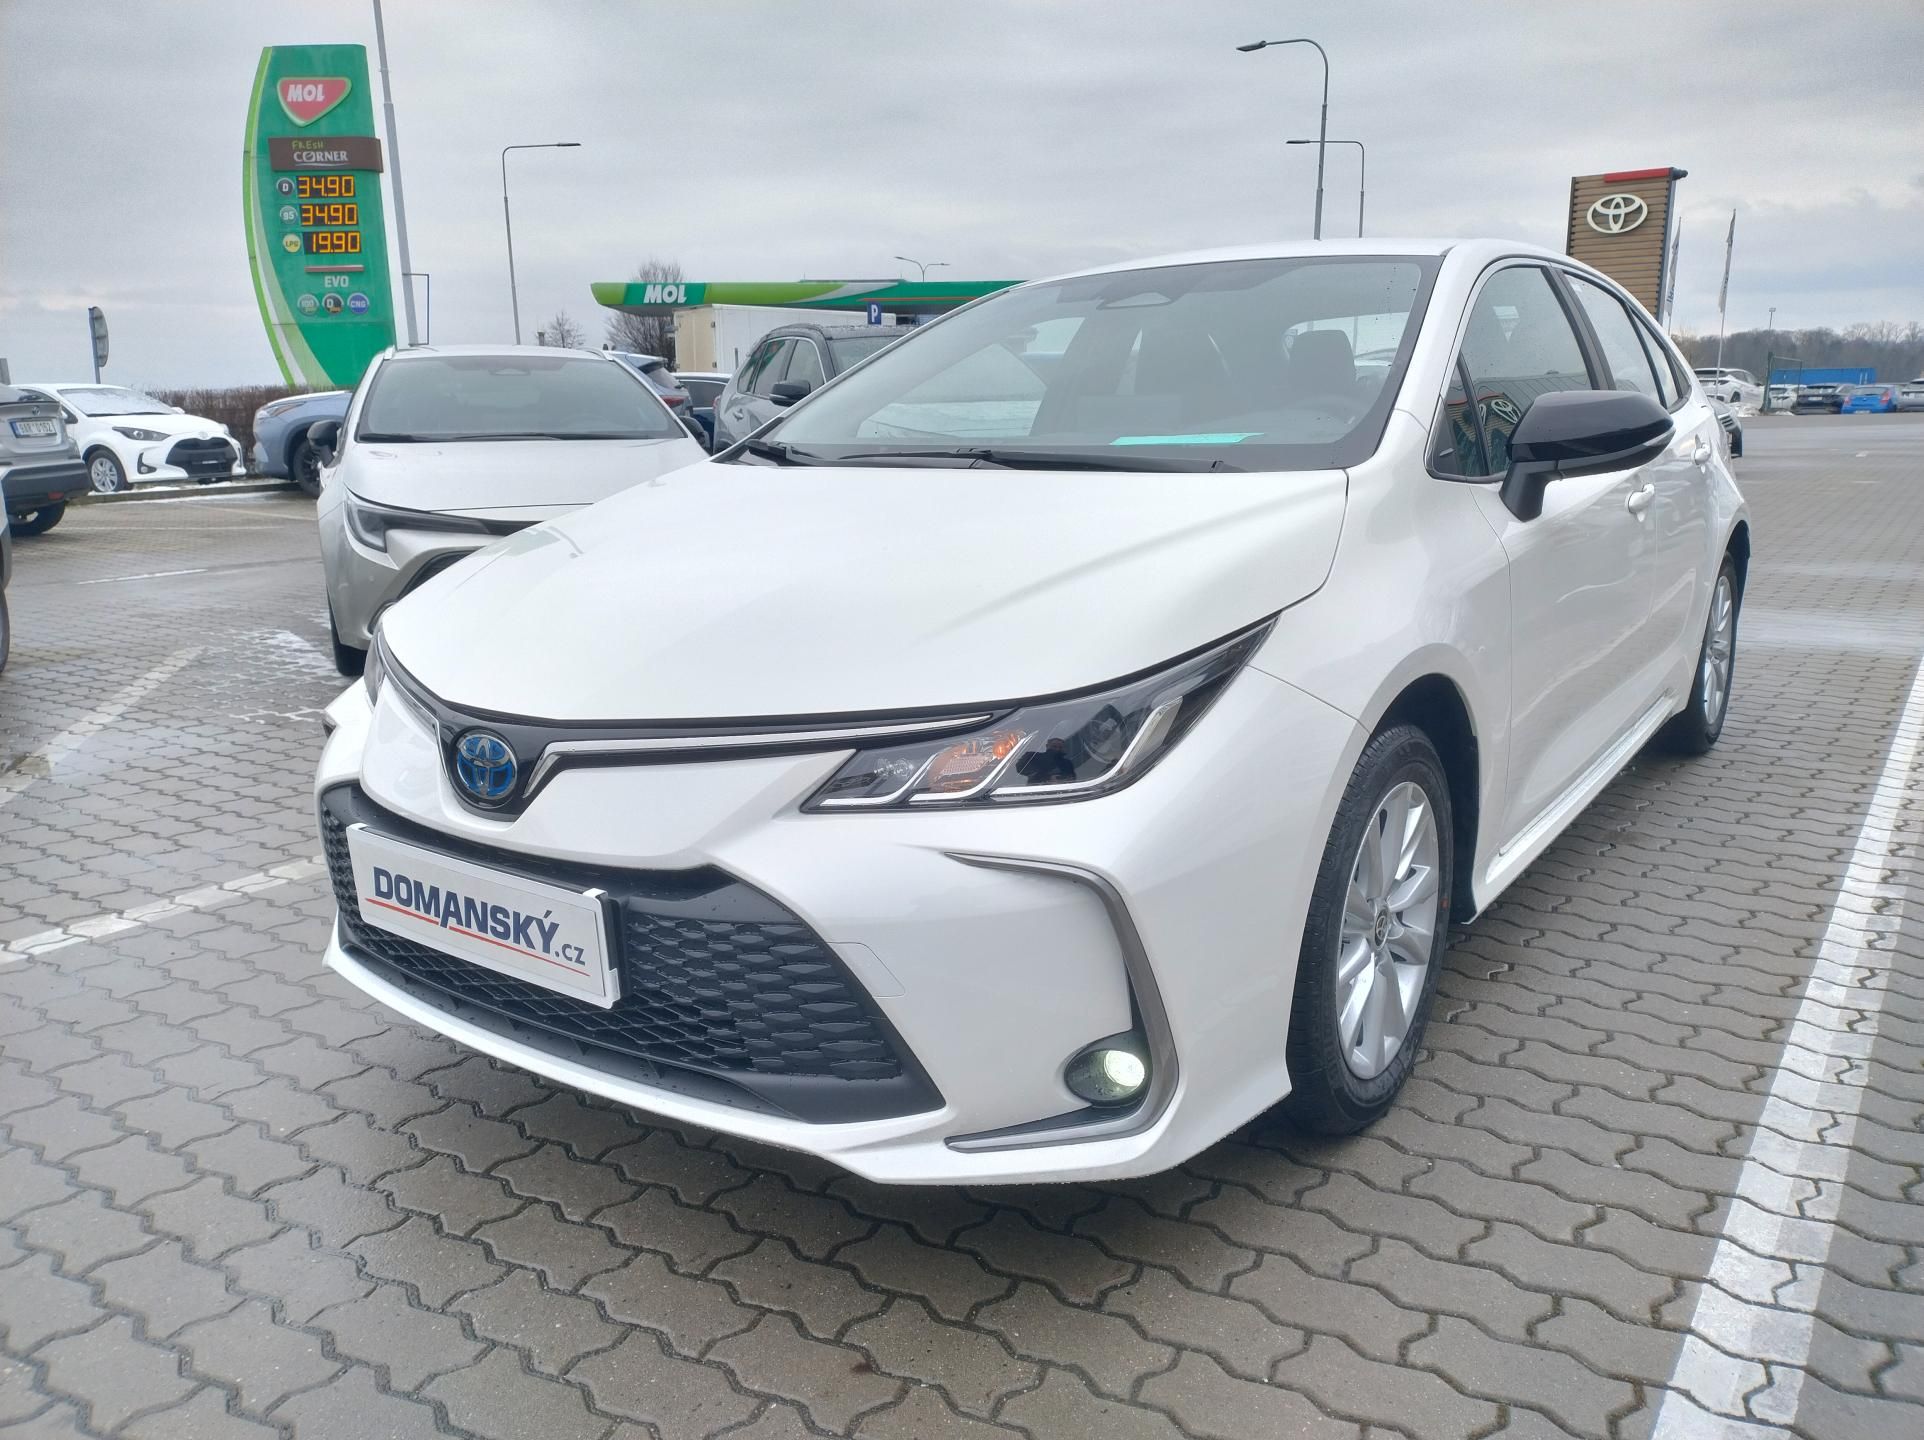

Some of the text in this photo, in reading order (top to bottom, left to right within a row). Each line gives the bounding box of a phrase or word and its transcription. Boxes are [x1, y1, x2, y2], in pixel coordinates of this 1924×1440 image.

[286, 84, 325, 102] MOL
[293, 151, 348, 163] CORNER
[324, 275, 349, 288] EVO
[643, 284, 687, 304] MOL
[871, 304, 879, 323] P
